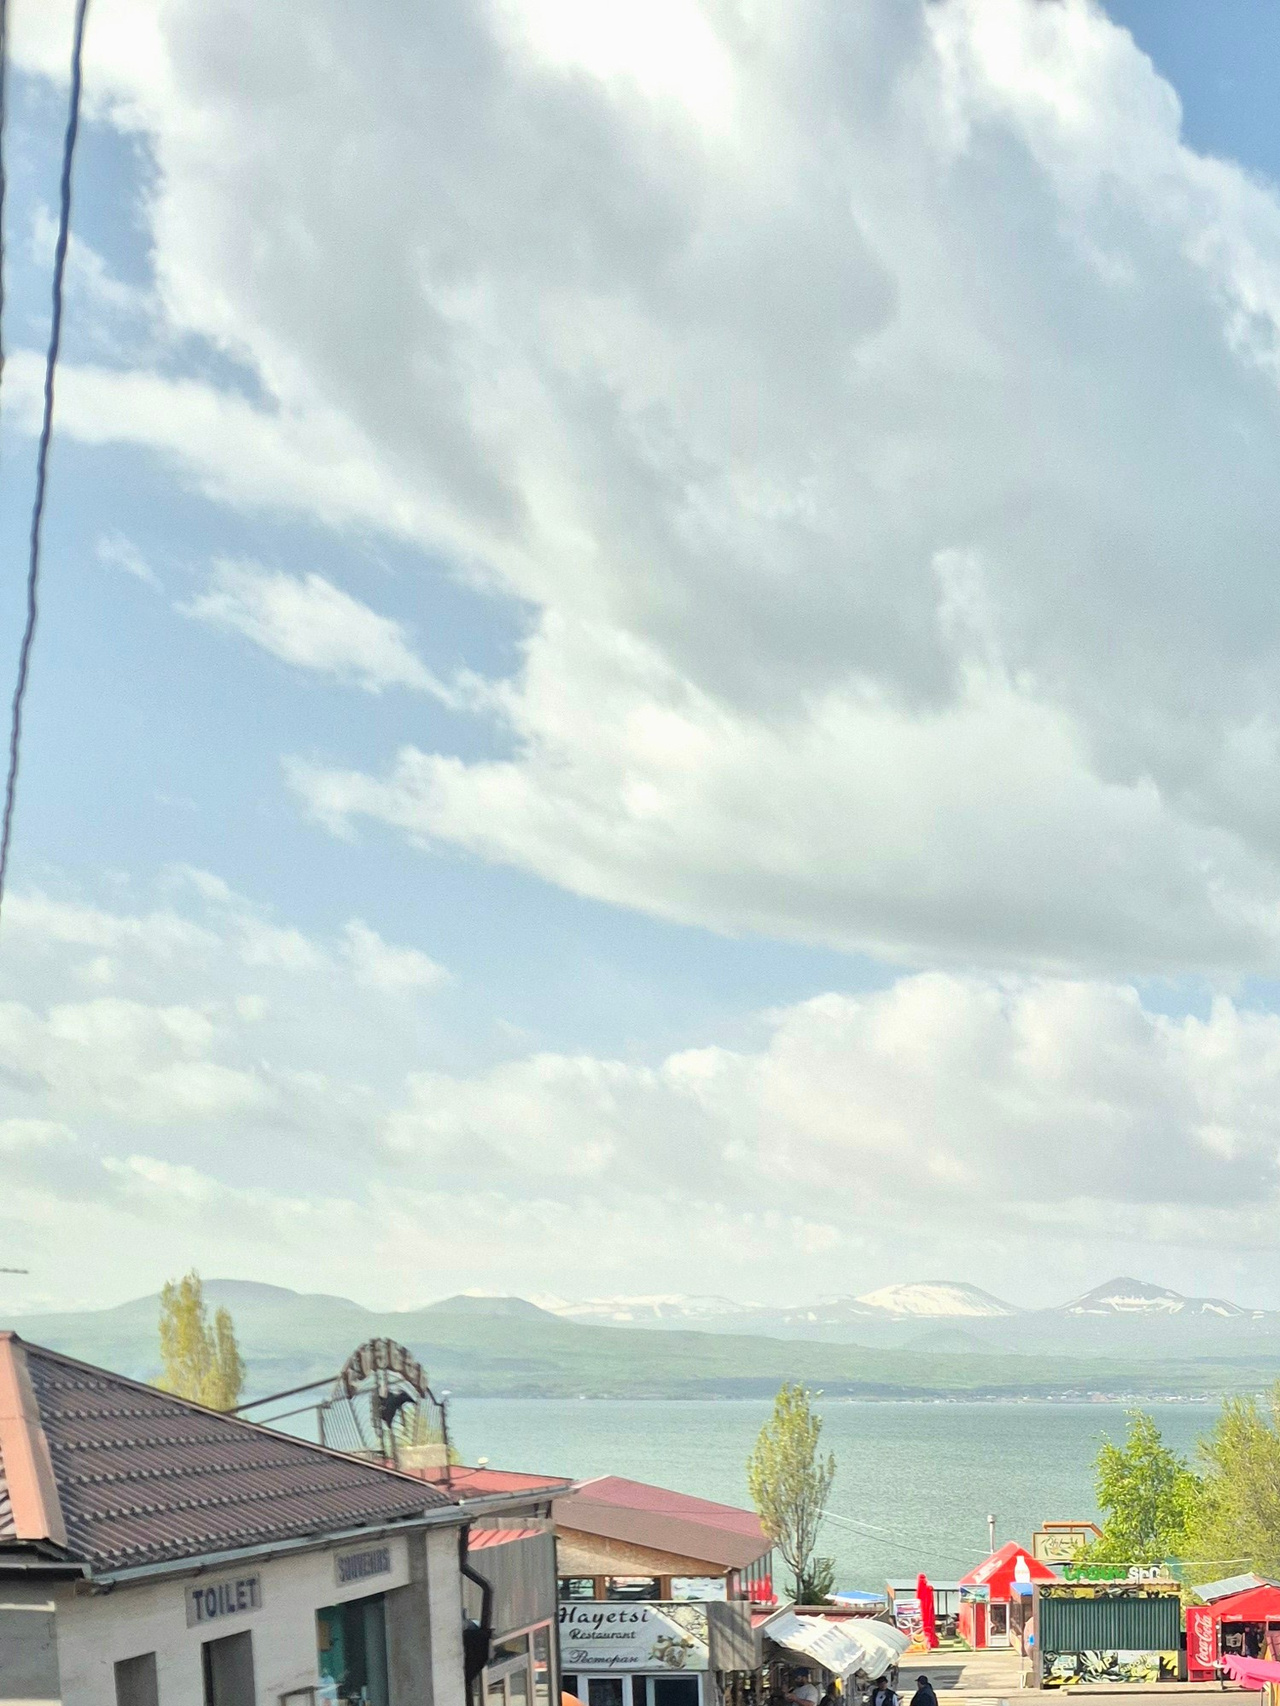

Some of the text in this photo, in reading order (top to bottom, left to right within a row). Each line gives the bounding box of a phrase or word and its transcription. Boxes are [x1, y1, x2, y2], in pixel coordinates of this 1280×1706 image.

[192, 1578, 257, 1620] TOILET
[559, 1606, 649, 1630] Hayetsi
[569, 1628, 637, 1640] Restaurant
[569, 1649, 639, 1667] Ресторан
